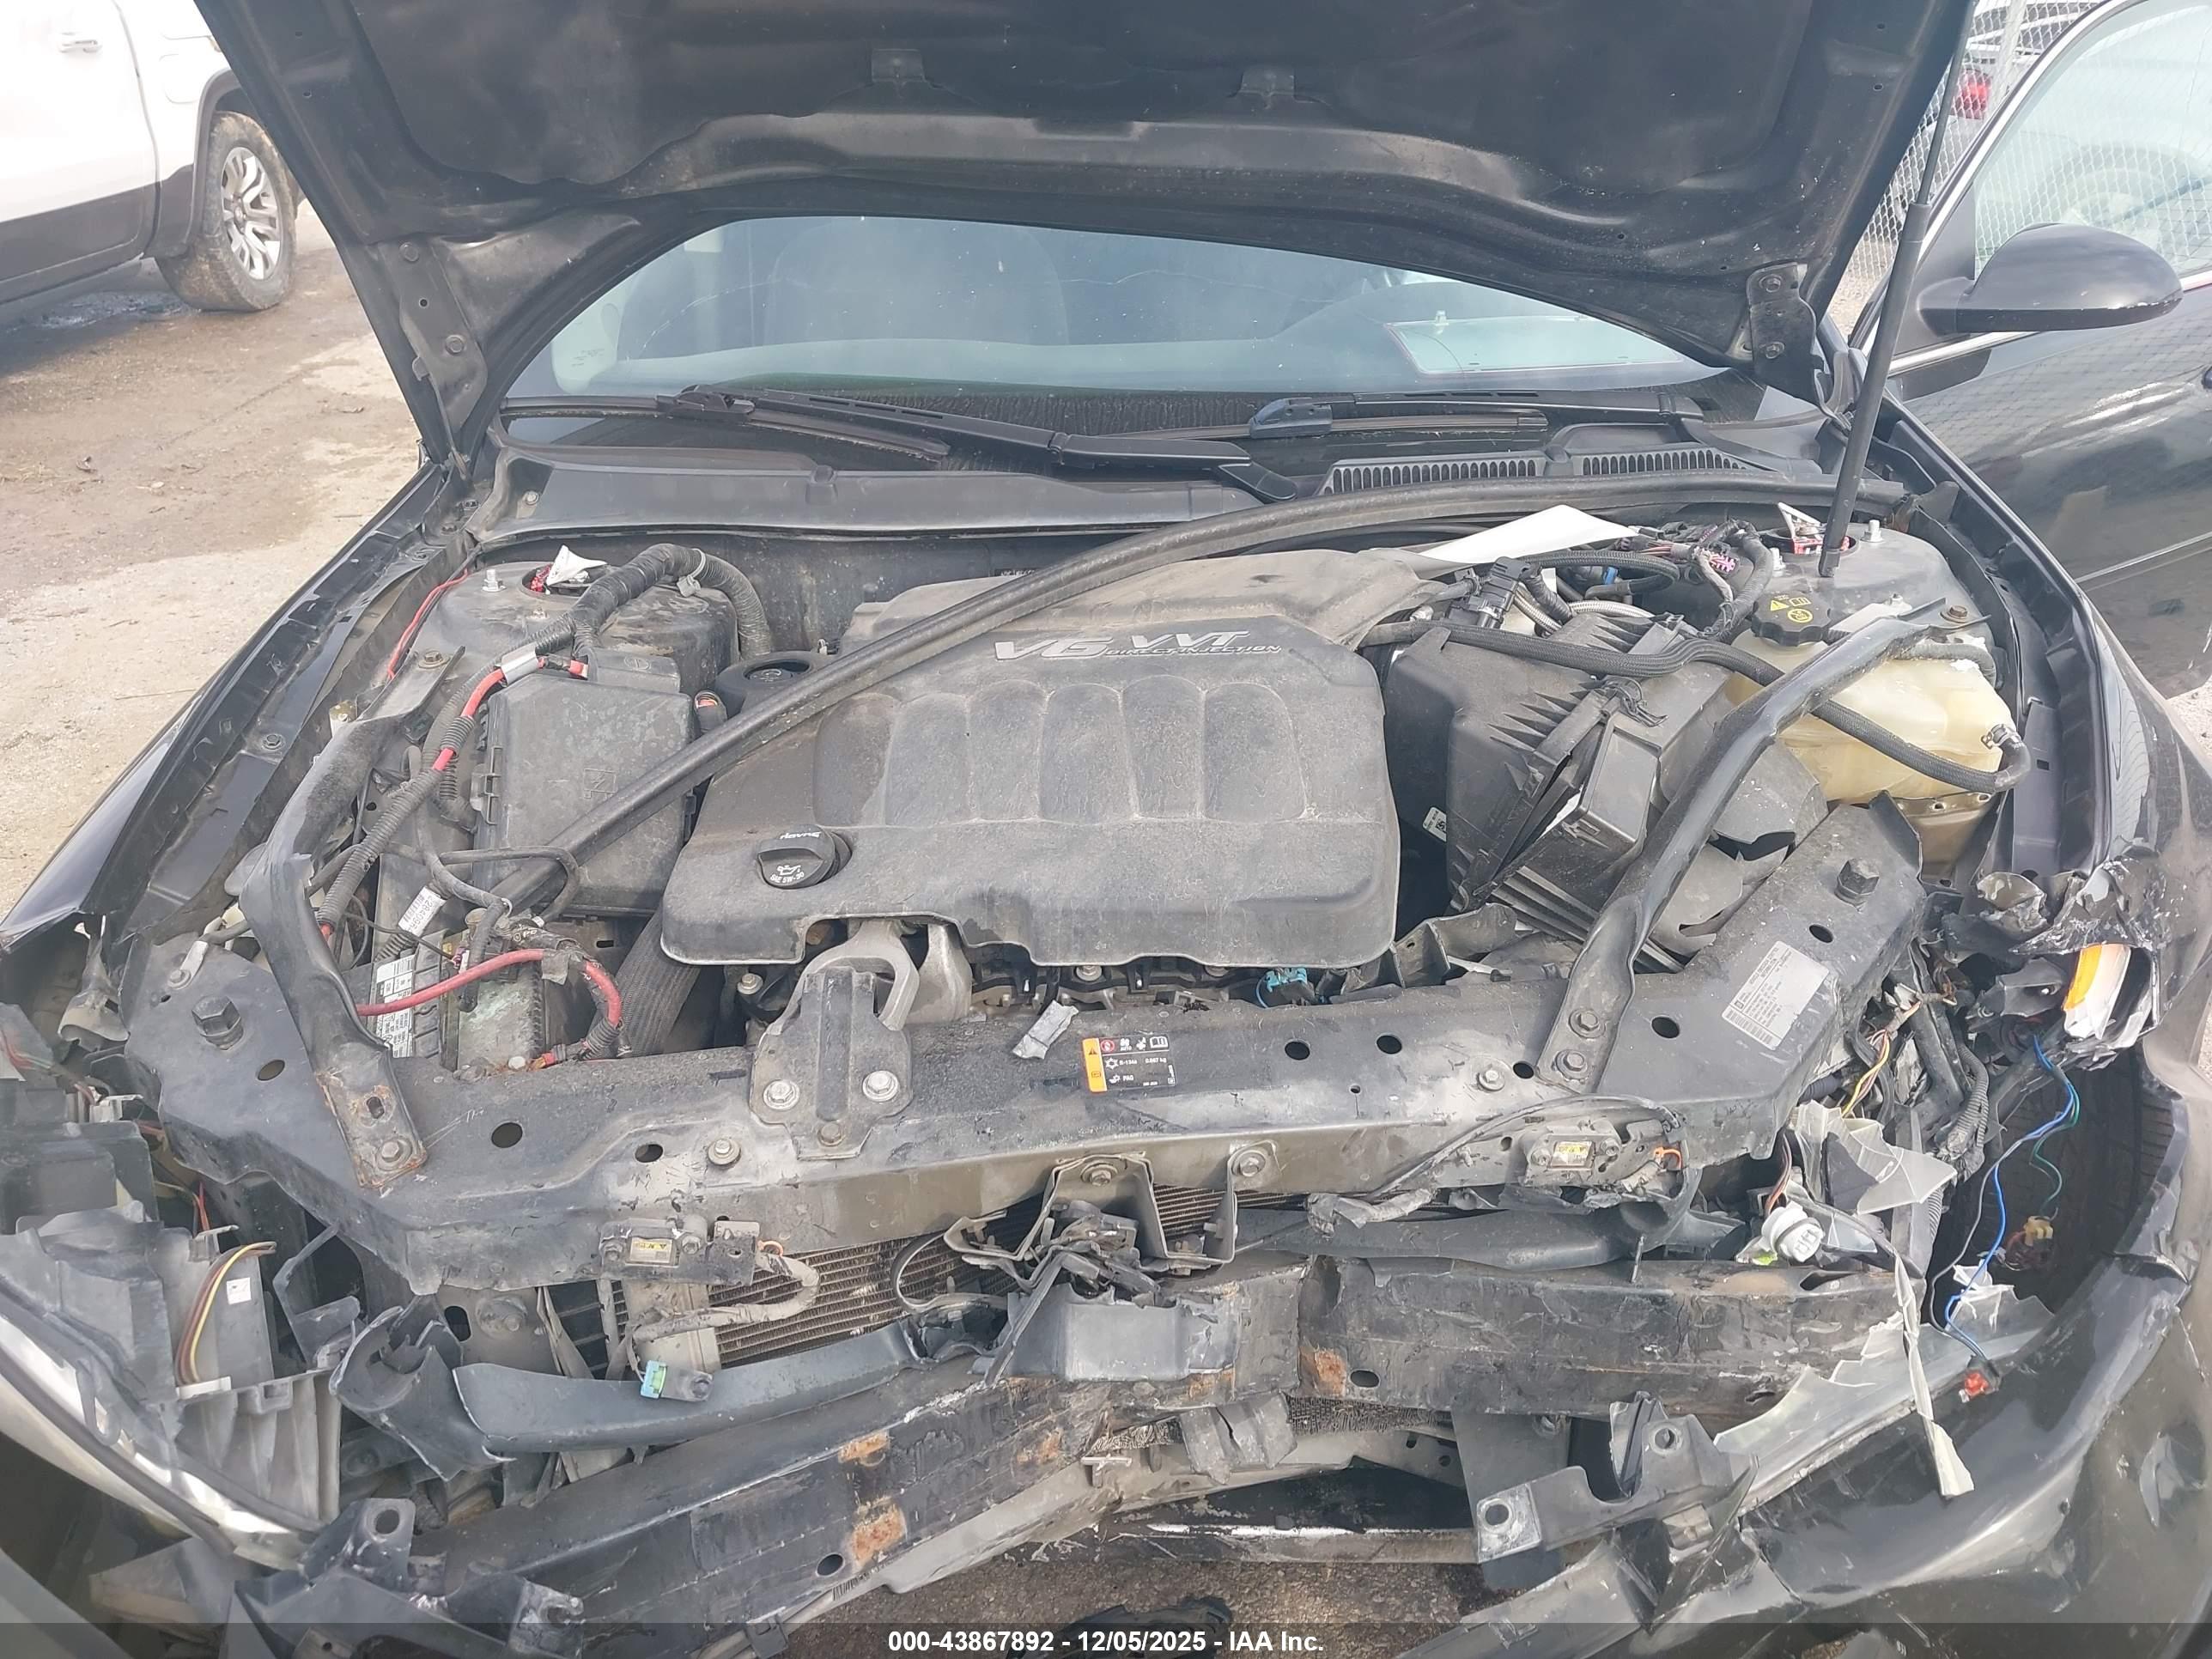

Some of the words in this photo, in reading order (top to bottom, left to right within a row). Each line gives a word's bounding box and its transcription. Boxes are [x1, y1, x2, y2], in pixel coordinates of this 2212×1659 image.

[994, 637, 1113, 660] V6
[1131, 630, 1250, 649] VVT
[1105, 647, 1177, 657] DIRECT
[1177, 645, 1282, 655] INJECTION
